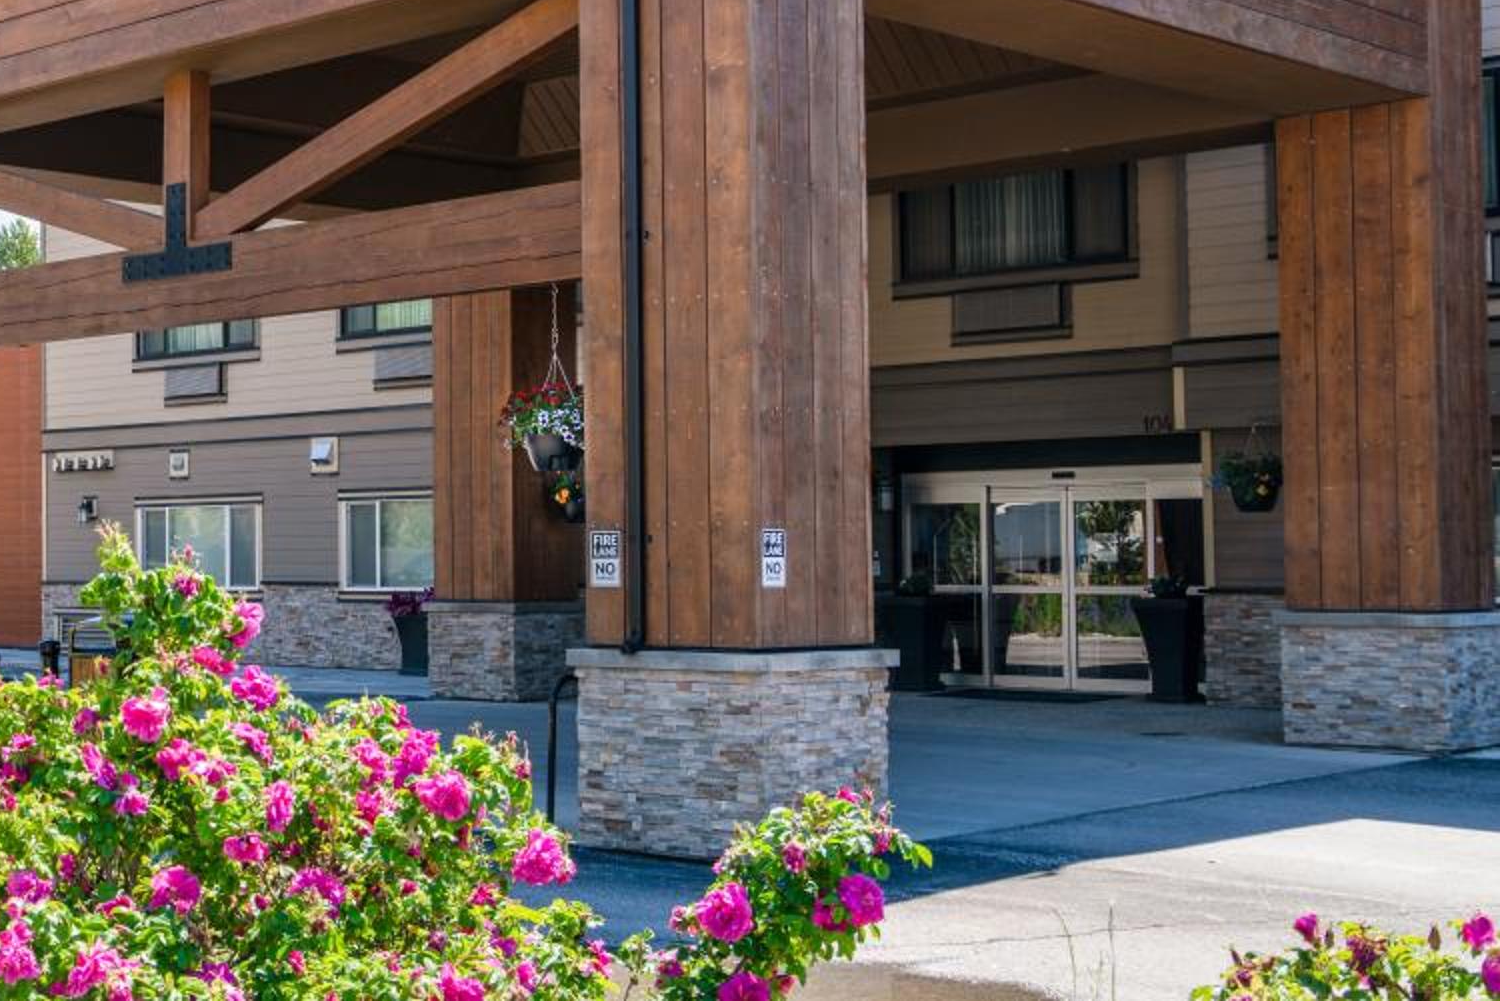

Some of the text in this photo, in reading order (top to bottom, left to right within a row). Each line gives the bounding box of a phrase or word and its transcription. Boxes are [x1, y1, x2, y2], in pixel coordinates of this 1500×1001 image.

[593, 534, 618, 546] FIRE
[763, 532, 783, 544] FIRE
[596, 562, 616, 576] NO
[766, 562, 781, 575] NO
